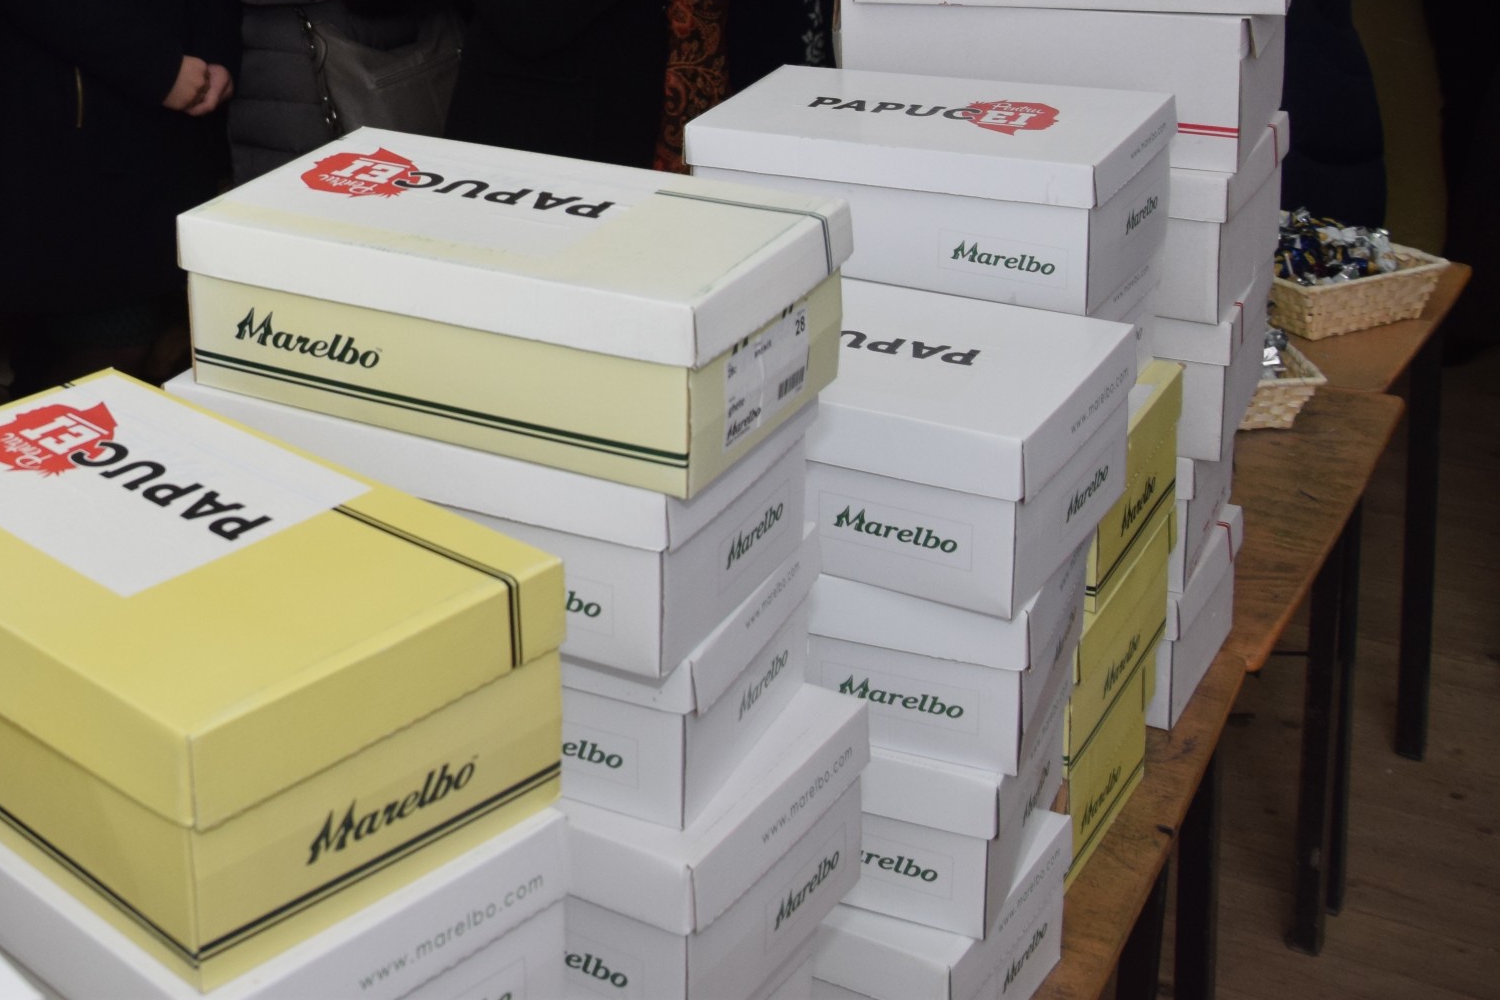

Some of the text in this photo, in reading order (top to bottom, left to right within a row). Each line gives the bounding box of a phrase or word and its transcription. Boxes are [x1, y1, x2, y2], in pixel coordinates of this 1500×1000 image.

[1124, 194, 1159, 236] Marelbo
[950, 239, 1056, 276] Marelbo
[234, 306, 381, 369] Marelbo
[795, 315, 806, 336] 28
[840, 330, 981, 366] PAPU
[726, 407, 762, 441] Marelbo
[1066, 465, 1109, 523] Marelbo
[1120, 476, 1156, 538] Marelbo
[725, 502, 784, 570] Marelbo
[833, 505, 958, 553] Marelbo
[738, 650, 788, 721] Marelbo
[839, 674, 964, 719] Marelbo
[562, 739, 623, 769] elbo
[306, 760, 476, 865] Marelbo
[762, 746, 852, 843] www.marelbo.com
[774, 851, 840, 931] Marelbo
[860, 851, 938, 882] relbo
[359, 874, 544, 990] www.marelbo.com
[1003, 922, 1048, 994] Marelbo
[564, 952, 628, 988] elbo
